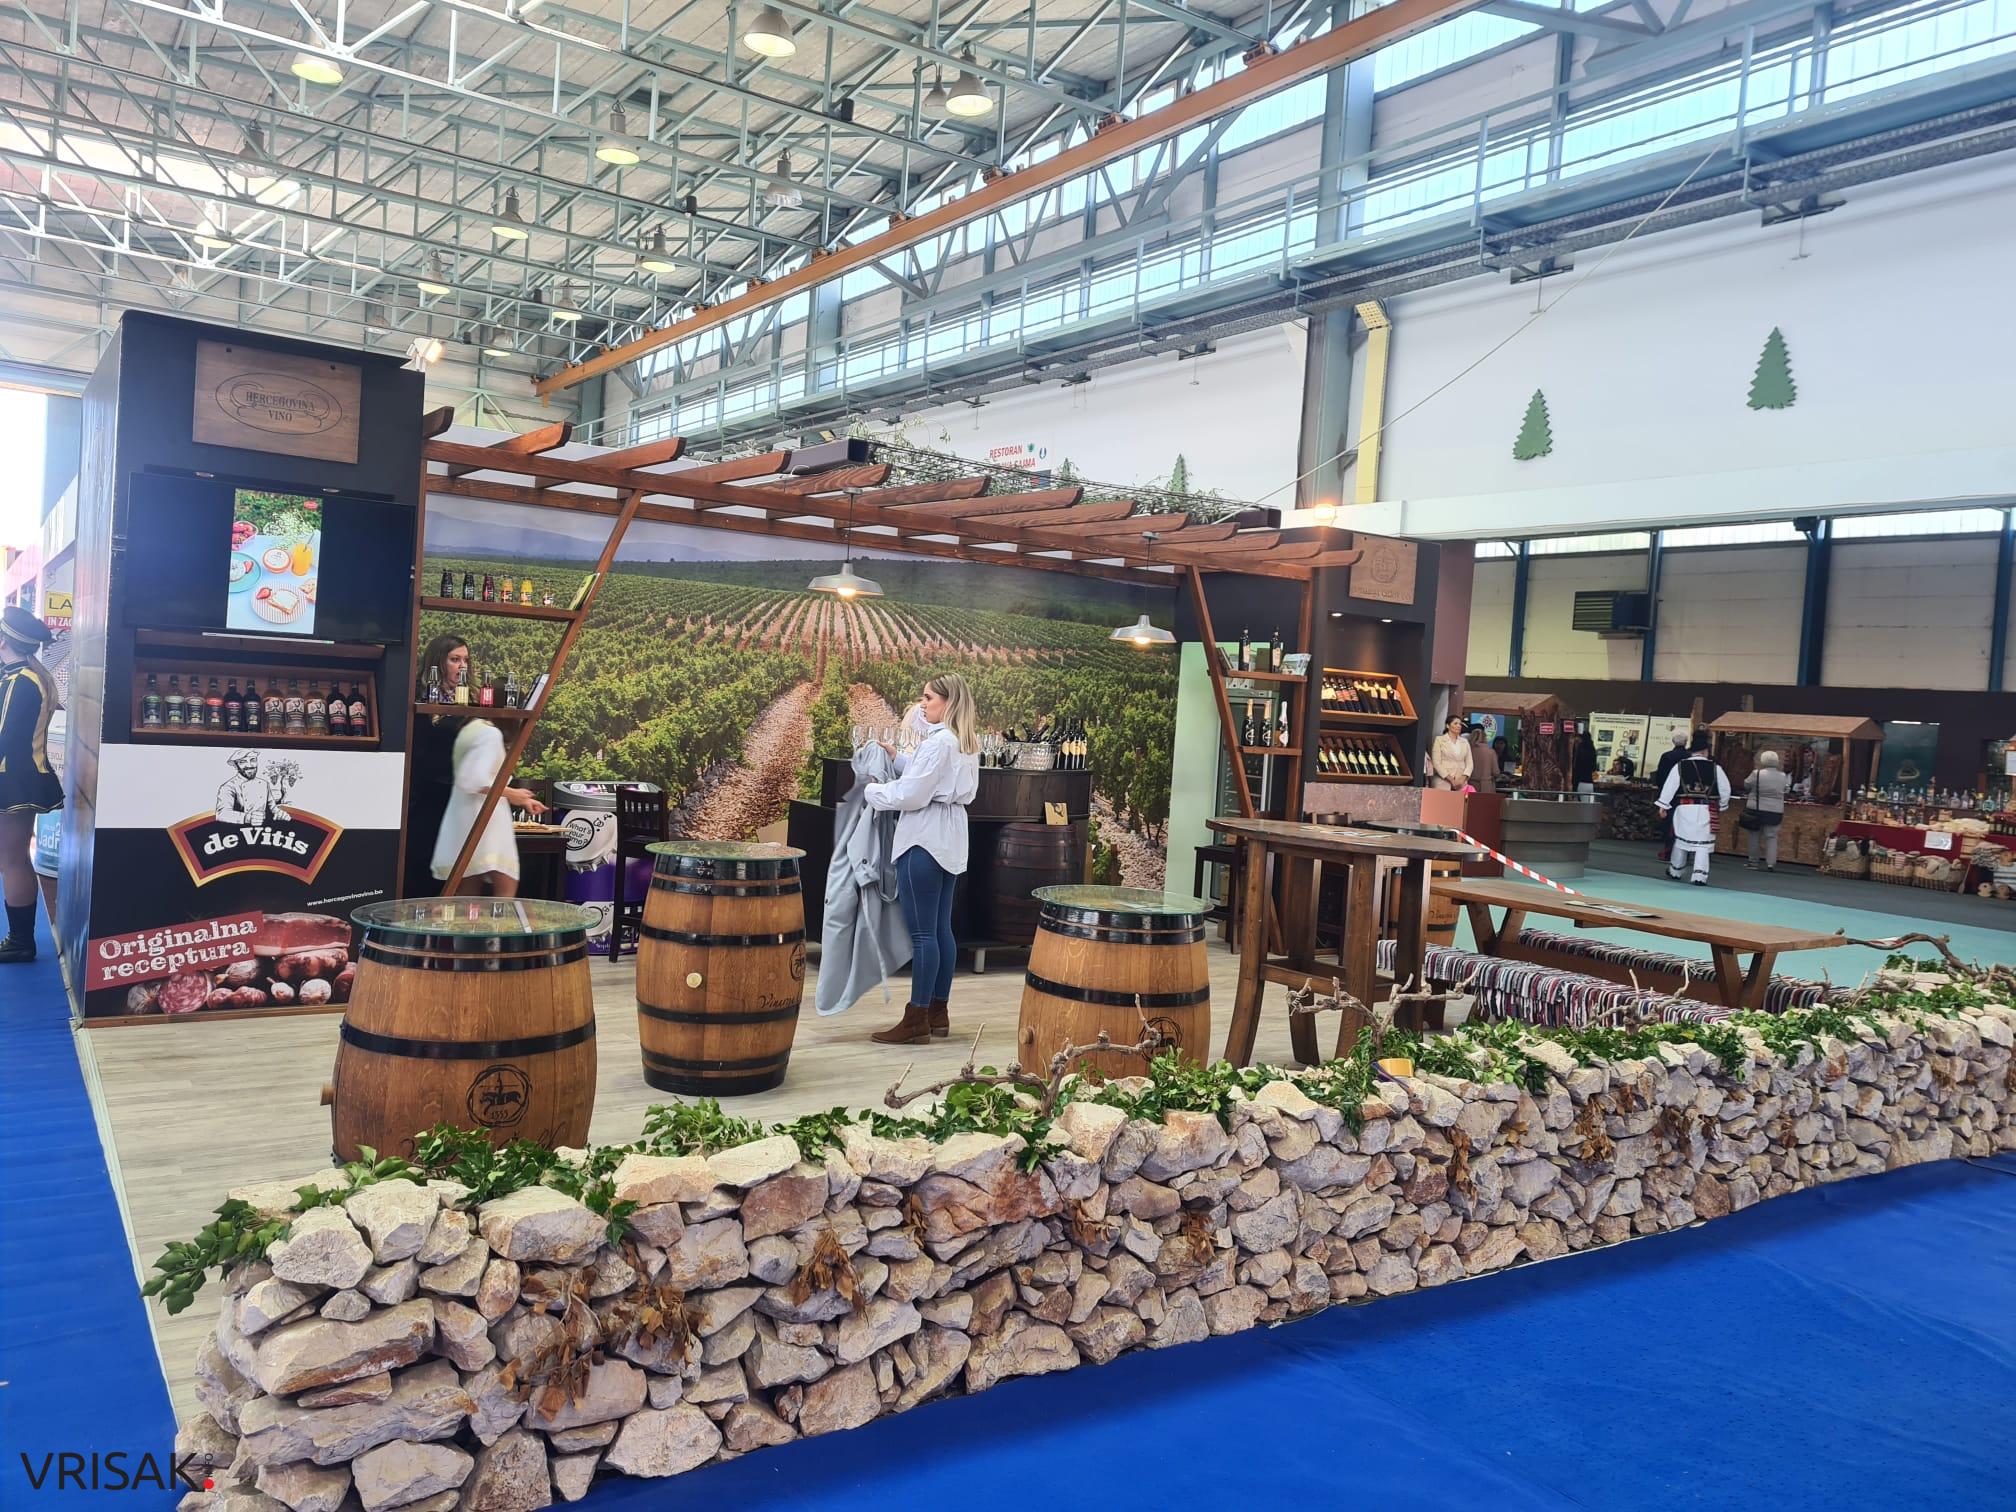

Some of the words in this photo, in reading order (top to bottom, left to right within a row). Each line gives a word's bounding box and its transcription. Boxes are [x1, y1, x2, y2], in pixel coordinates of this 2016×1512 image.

[246, 391, 315, 411] HERCEGOVINA
[268, 410, 293, 422] VINO
[989, 444, 1023, 458] RESTORAN
[203, 833, 239, 855] de
[240, 827, 309, 855] Vitis
[100, 920, 258, 960] Originalna
[102, 941, 250, 981] receptura
